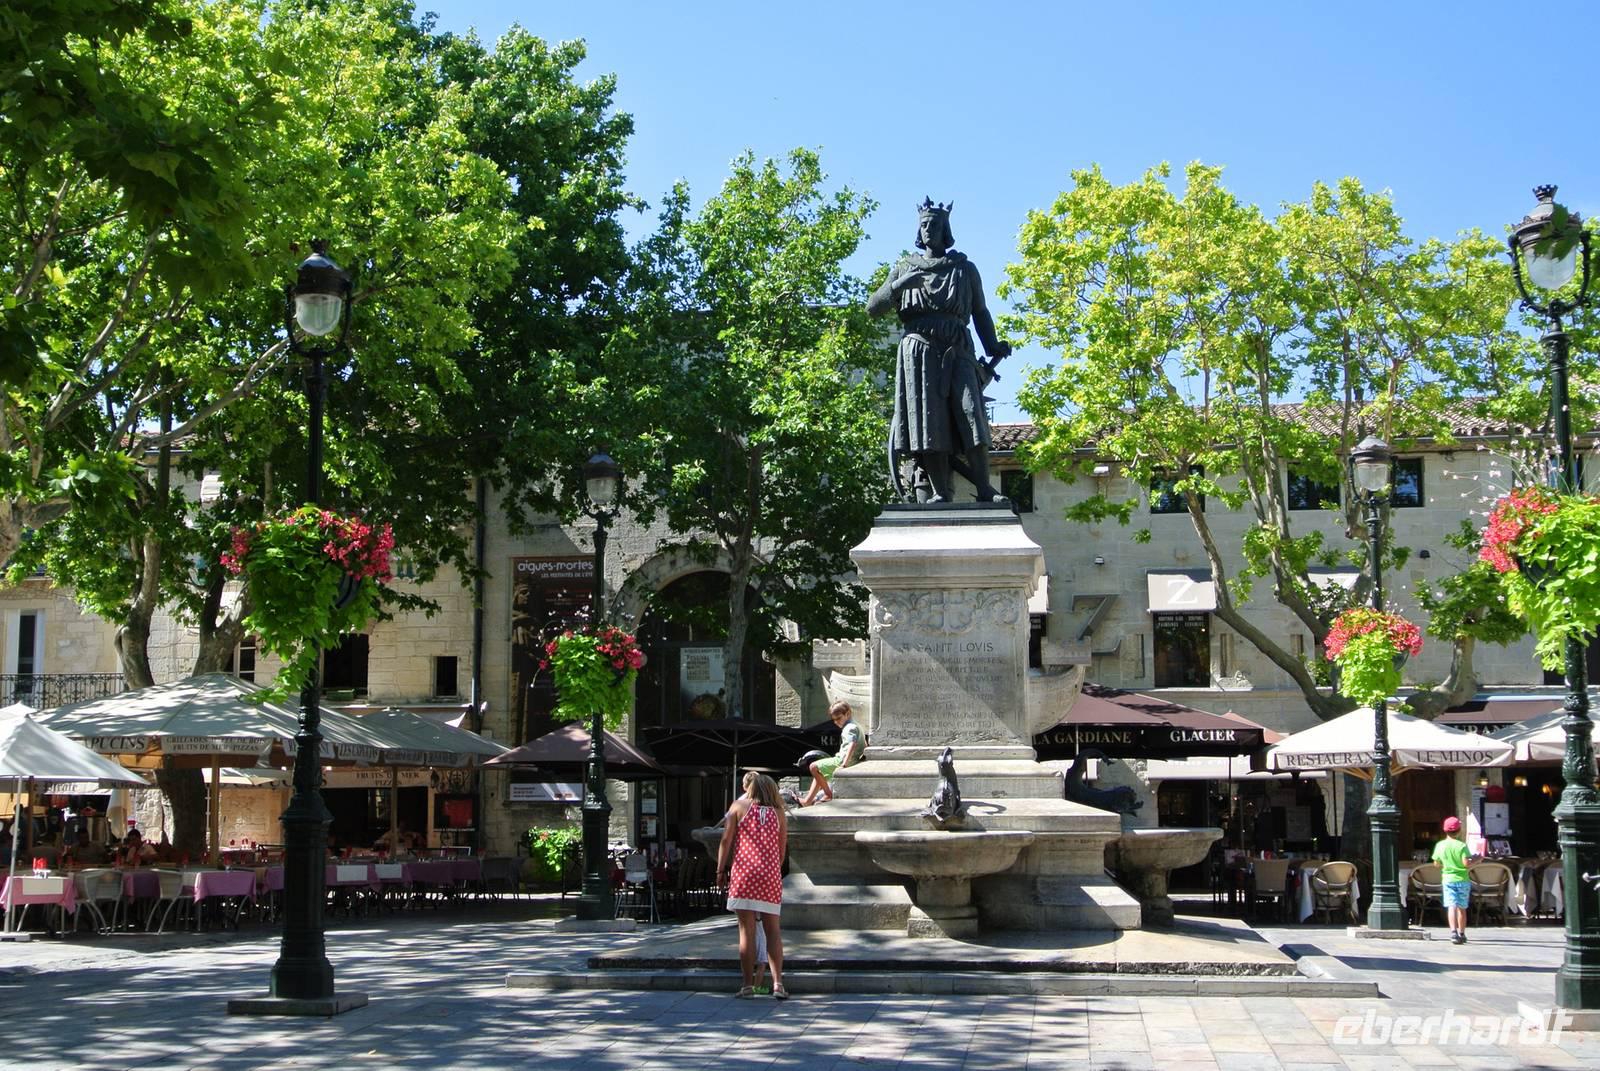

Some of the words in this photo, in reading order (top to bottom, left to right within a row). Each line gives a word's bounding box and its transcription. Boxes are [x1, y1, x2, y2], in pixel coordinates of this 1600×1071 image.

[517, 560, 594, 574] aigues-mortes
[1167, 579, 1198, 605] Z
[960, 642, 994, 653] LOVIS
[1054, 730, 1132, 745] GARDIANE
[1170, 729, 1236, 743] GLACIER
[1287, 752, 1374, 767] RESTAURAN
[1416, 750, 1435, 763] LE
[1440, 750, 1493, 763] MINOS
[401, 771, 420, 779] MER
